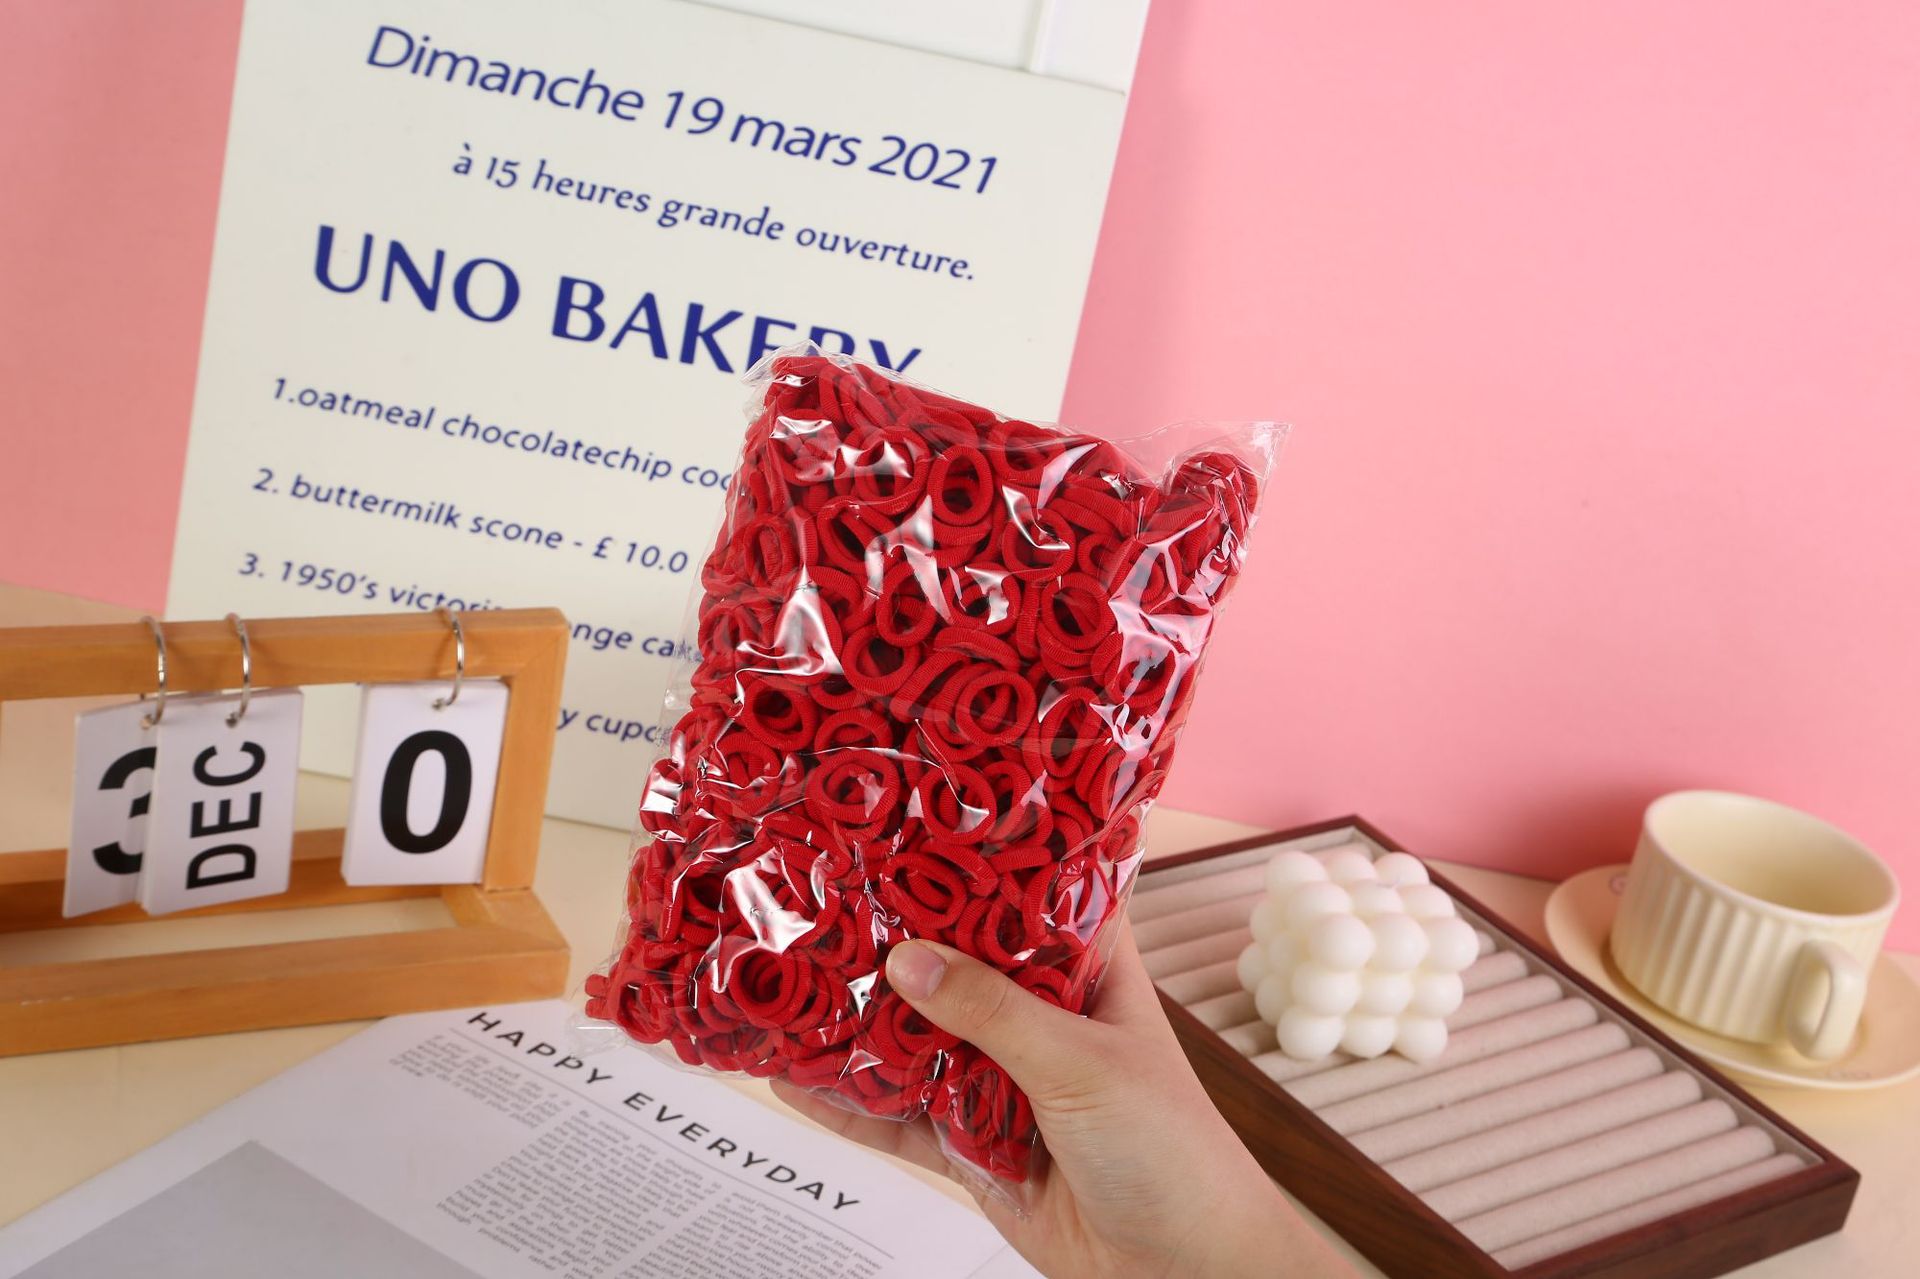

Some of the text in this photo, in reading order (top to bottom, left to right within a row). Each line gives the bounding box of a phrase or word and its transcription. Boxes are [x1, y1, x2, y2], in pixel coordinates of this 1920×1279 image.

[367, 26, 997, 194] Dimanche 19 mars 2021
[315, 225, 520, 322] UNO
[453, 143, 972, 280] à 15 heures grande ouverture.
[442, 417, 672, 480] chocolatechip
[253, 468, 277, 493] 2.
[290, 475, 460, 528] buttermilk
[470, 517, 563, 549] scone
[593, 537, 612, 558] £
[627, 542, 688, 573] 10.0
[239, 553, 263, 577] 3.
[282, 561, 378, 599] 1950's
[389, 586, 502, 611] victo
[570, 623, 633, 651] nge
[185, 741, 265, 890] DEC
[380, 730, 472, 854] 0
[467, 1012, 612, 1084] HAPPY
[622, 1091, 860, 1211] EVERYDAY
